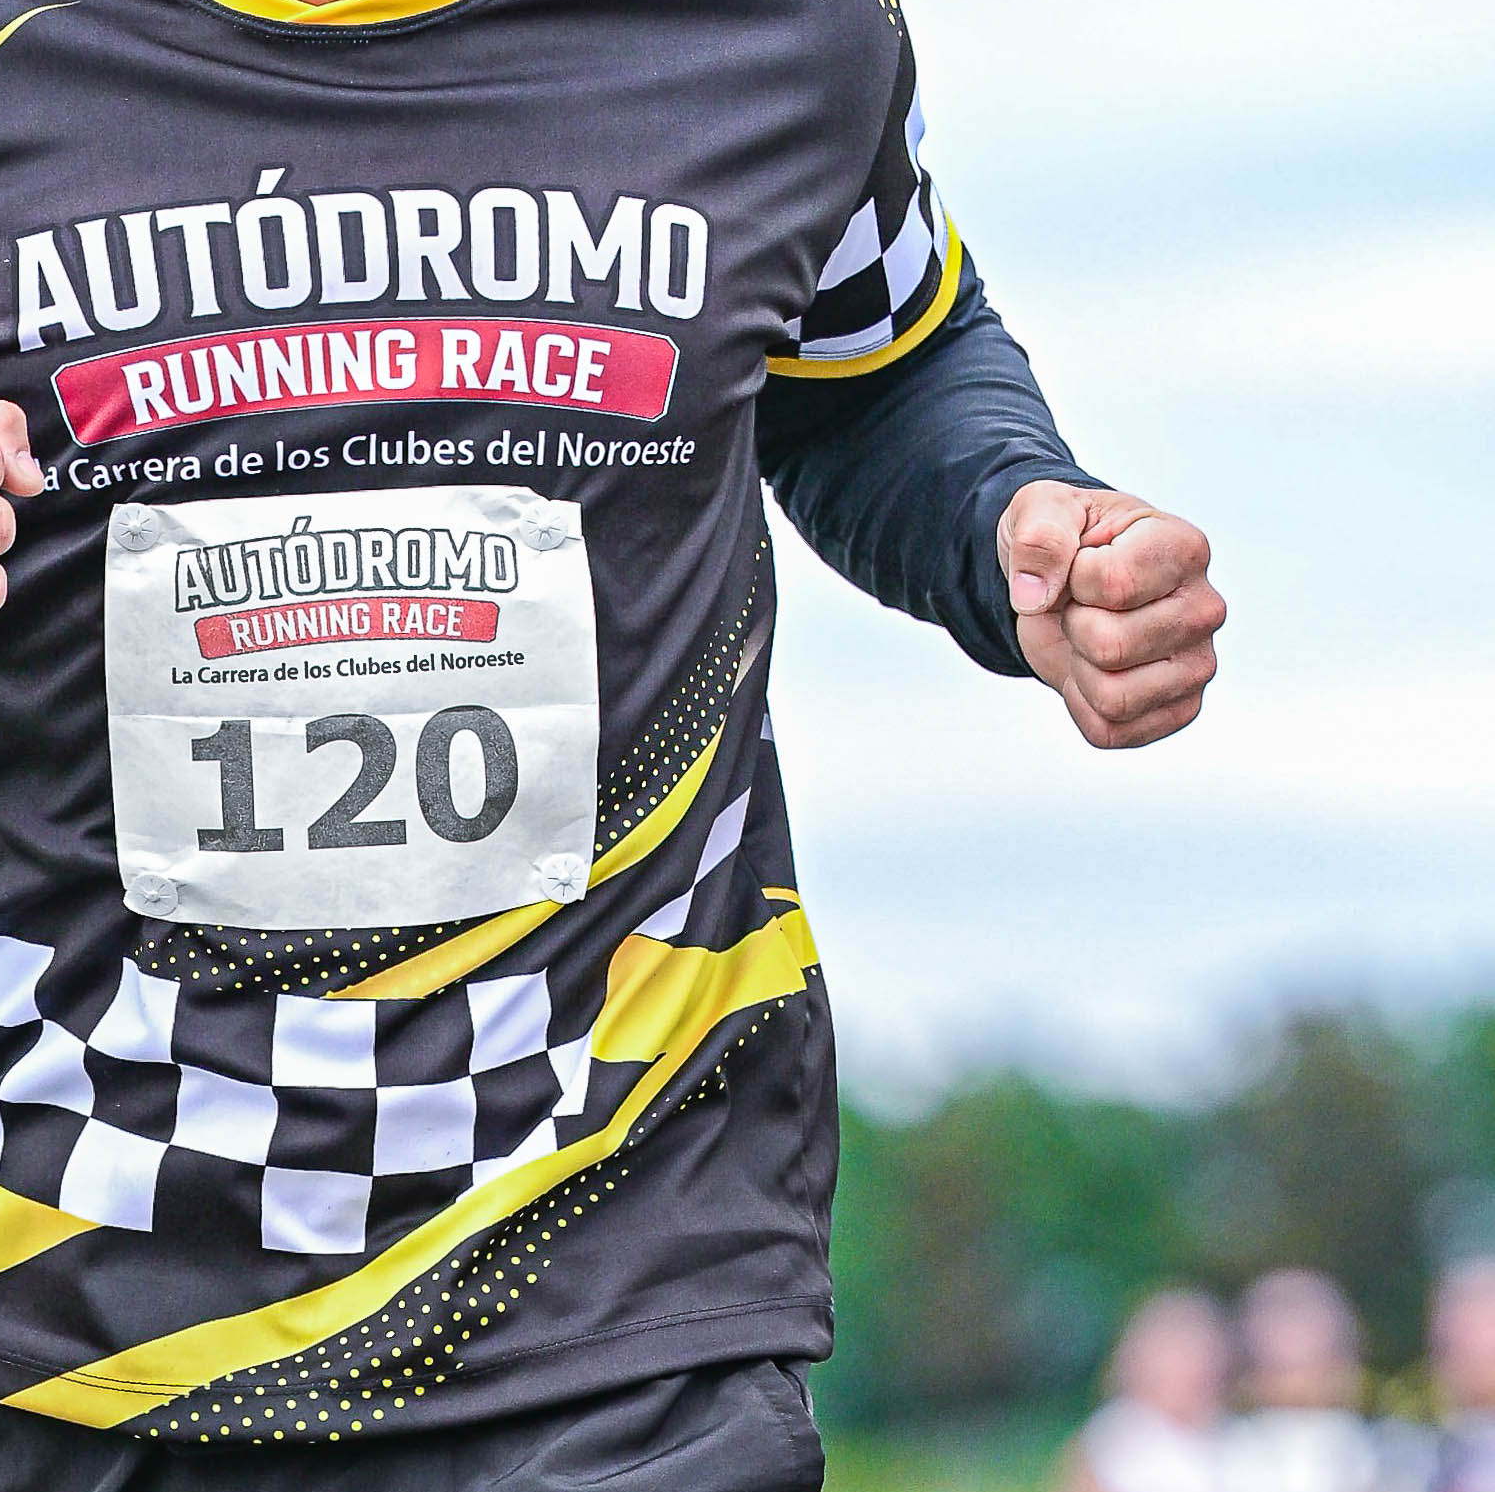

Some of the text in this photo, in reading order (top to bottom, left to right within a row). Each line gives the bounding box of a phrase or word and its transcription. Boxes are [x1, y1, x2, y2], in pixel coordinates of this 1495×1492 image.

[16, 168, 710, 353] AUTÓDROMO
[121, 328, 614, 427] RUNNING RACE
[68, 455, 201, 490] Carrera
[214, 443, 264, 477] de
[275, 440, 330, 472] los
[342, 430, 475, 467] Clubes
[486, 430, 547, 467] del
[556, 432, 697, 467] Noroeste
[175, 515, 519, 612] AUTÓDROMO
[171, 650, 525, 685] La Carrera de los Clubes del Noroeste
[229, 602, 465, 651] RUNNING RACE
[191, 704, 519, 853] 120
